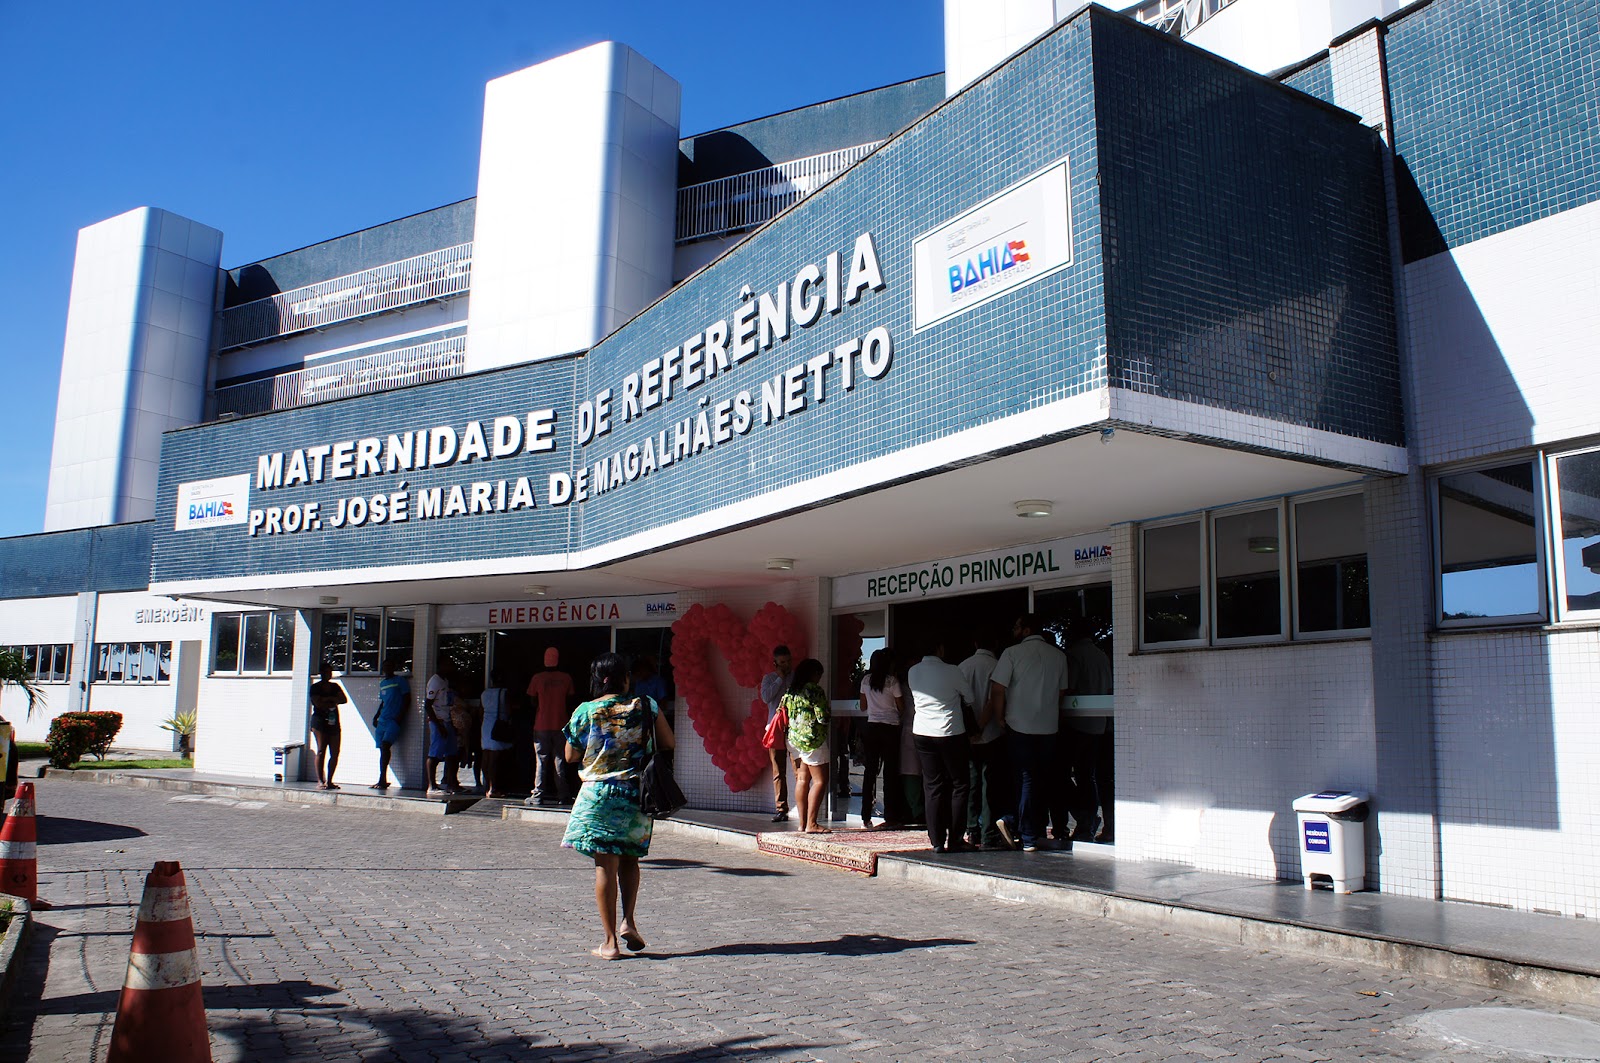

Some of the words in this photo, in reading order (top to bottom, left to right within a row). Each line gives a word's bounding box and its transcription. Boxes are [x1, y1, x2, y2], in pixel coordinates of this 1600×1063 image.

[949, 241, 1017, 293] BAHIA
[951, 280, 989, 302] GOVERNO
[991, 275, 1002, 286] DO
[1003, 262, 1032, 280] ESTADO
[257, 408, 557, 491] MATERNIDADE
[578, 388, 613, 447] DE
[621, 232, 886, 423] REFERÊNCIA
[249, 502, 323, 537] PROF.
[330, 481, 409, 528] JOSÉ
[417, 476, 537, 520] MARIA
[549, 467, 589, 507] DE
[593, 390, 755, 496] MAGALHÃES
[762, 326, 894, 426] NETTO
[189, 501, 226, 520] BAHIA
[867, 563, 953, 596] RECEPÇÃO
[959, 549, 1059, 585] PRINCIPAL
[1075, 545, 1107, 560] BAHIA
[489, 601, 620, 624] EMERGÊNCIA
[647, 603, 671, 611] BAHIA
